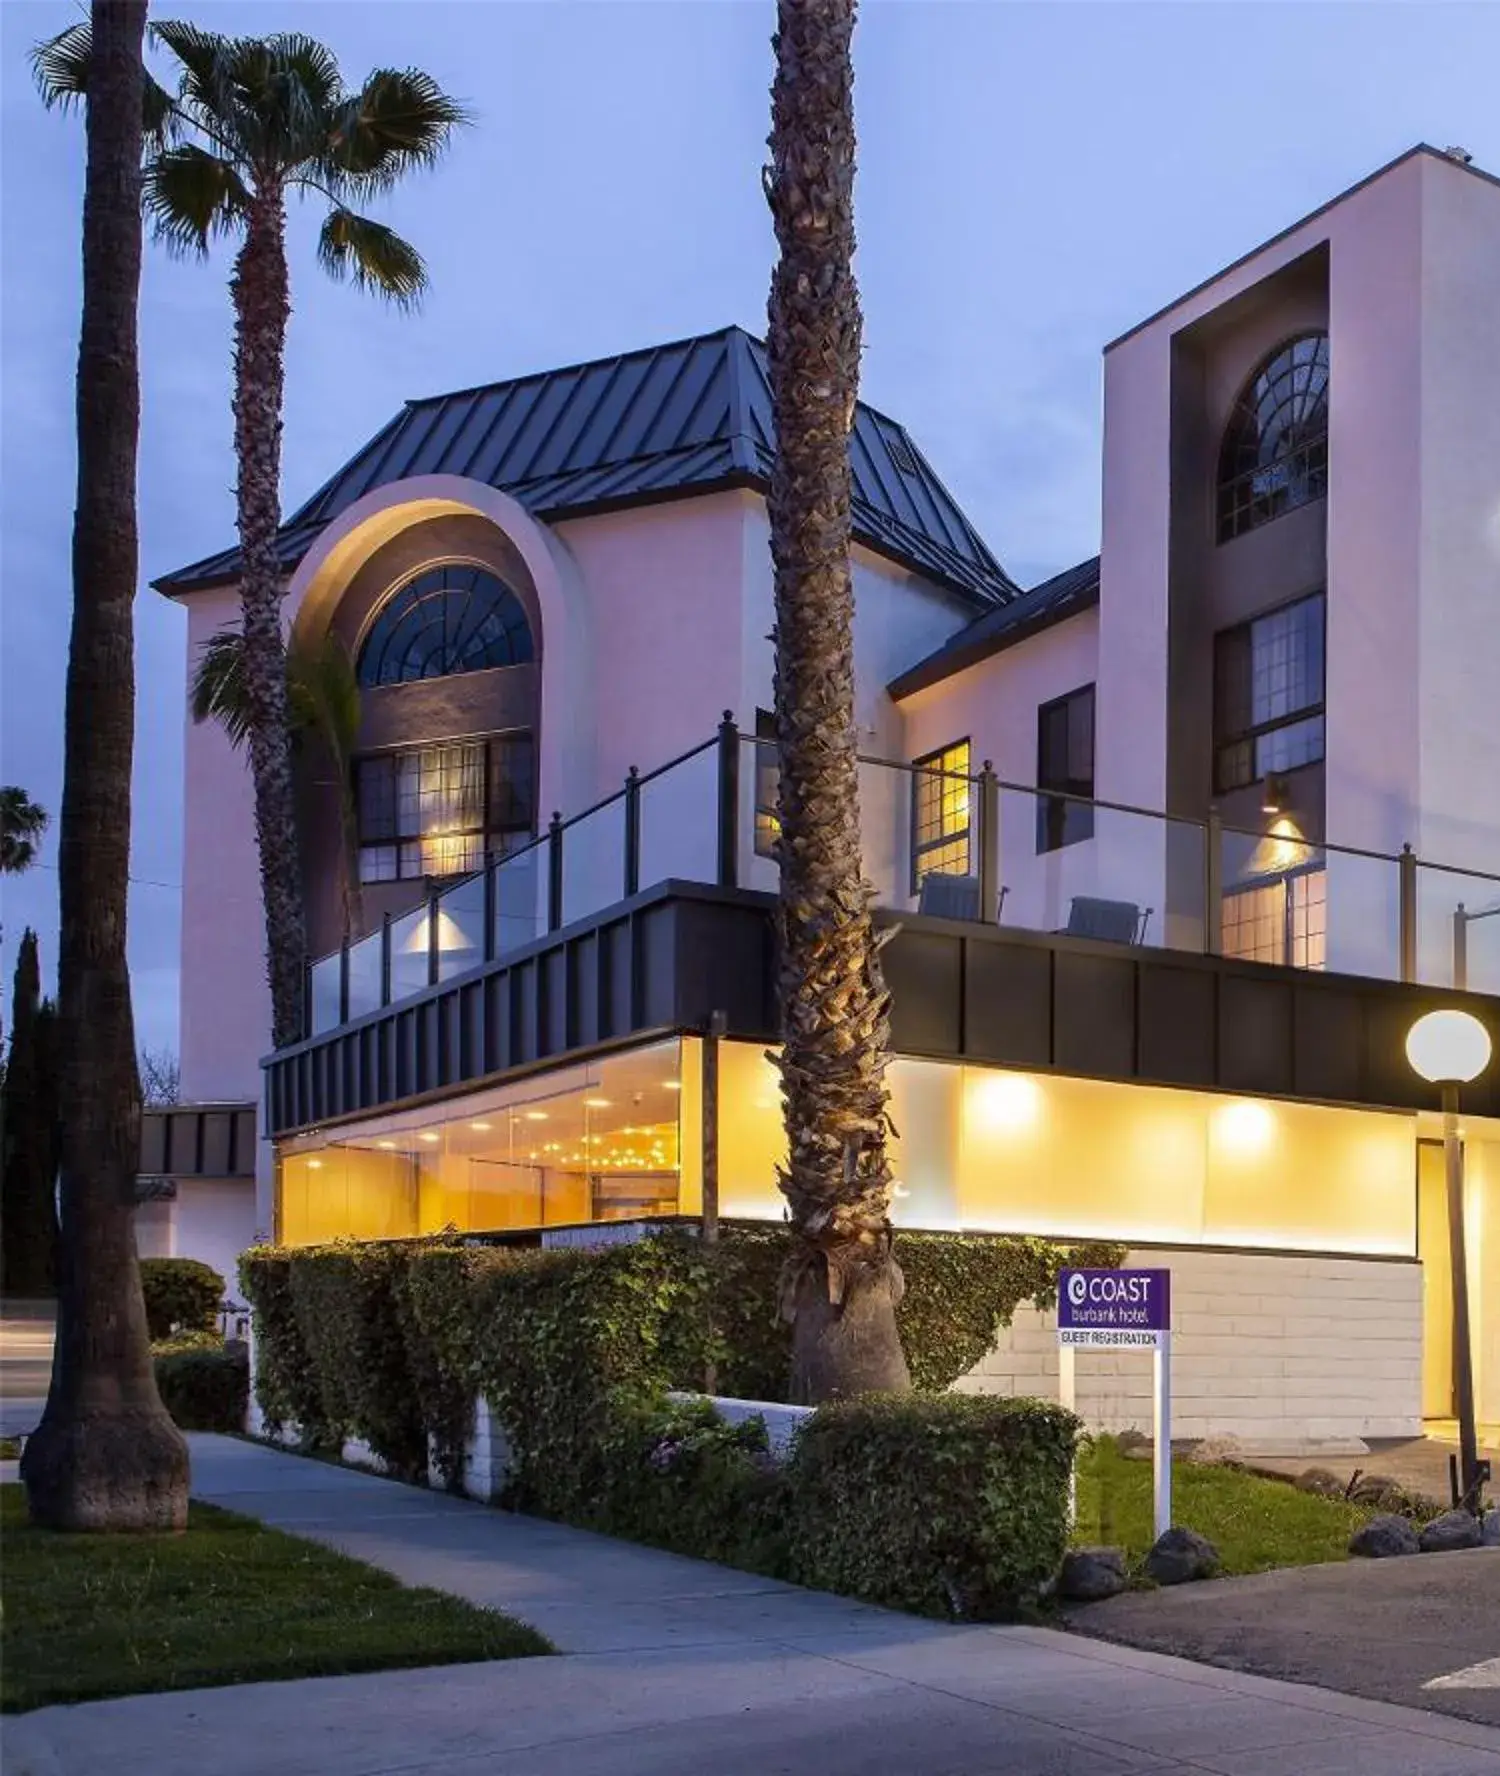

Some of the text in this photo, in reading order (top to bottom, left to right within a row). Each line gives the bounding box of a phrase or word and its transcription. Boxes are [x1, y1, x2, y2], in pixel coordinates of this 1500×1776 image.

[1089, 1277, 1151, 1302] COAST
[1071, 1306, 1116, 1322] burbank
[1061, 1331, 1157, 1345] GUEST REGISTRATION
